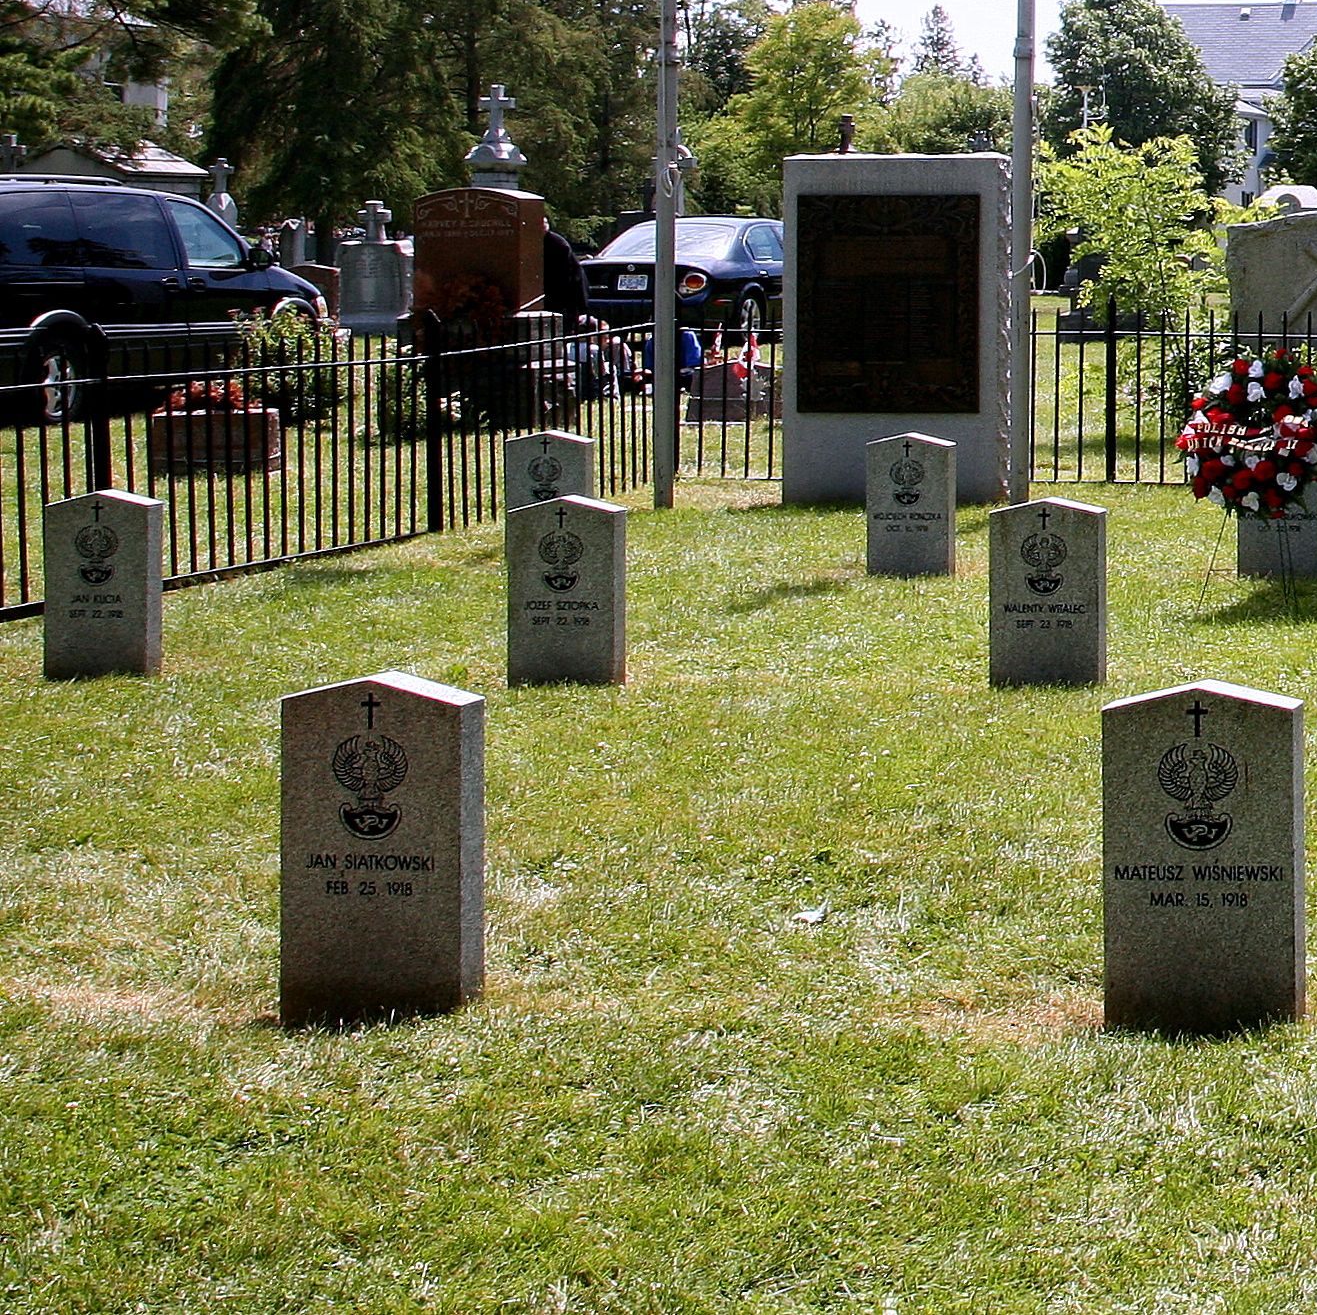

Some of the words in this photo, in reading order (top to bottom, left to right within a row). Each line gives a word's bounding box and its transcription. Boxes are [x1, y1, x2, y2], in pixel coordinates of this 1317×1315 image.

[1196, 422, 1247, 436] POLISH
[1286, 439, 1299, 450] 17
[71, 594, 90, 604] JAN
[1003, 603, 1045, 614] WALENTY
[1057, 619, 1073, 629] 1918
[305, 853, 337, 869] JAN
[344, 854, 436, 872] SIATKOWSKI
[1114, 865, 1185, 882] MATEUSZ
[1192, 858, 1283, 882] WIŚNIEWSKI
[387, 881, 414, 897] 1918
[1150, 892, 1189, 907] MAR.
[1196, 892, 1214, 908] 15,
[1221, 892, 1248, 907] 1918
